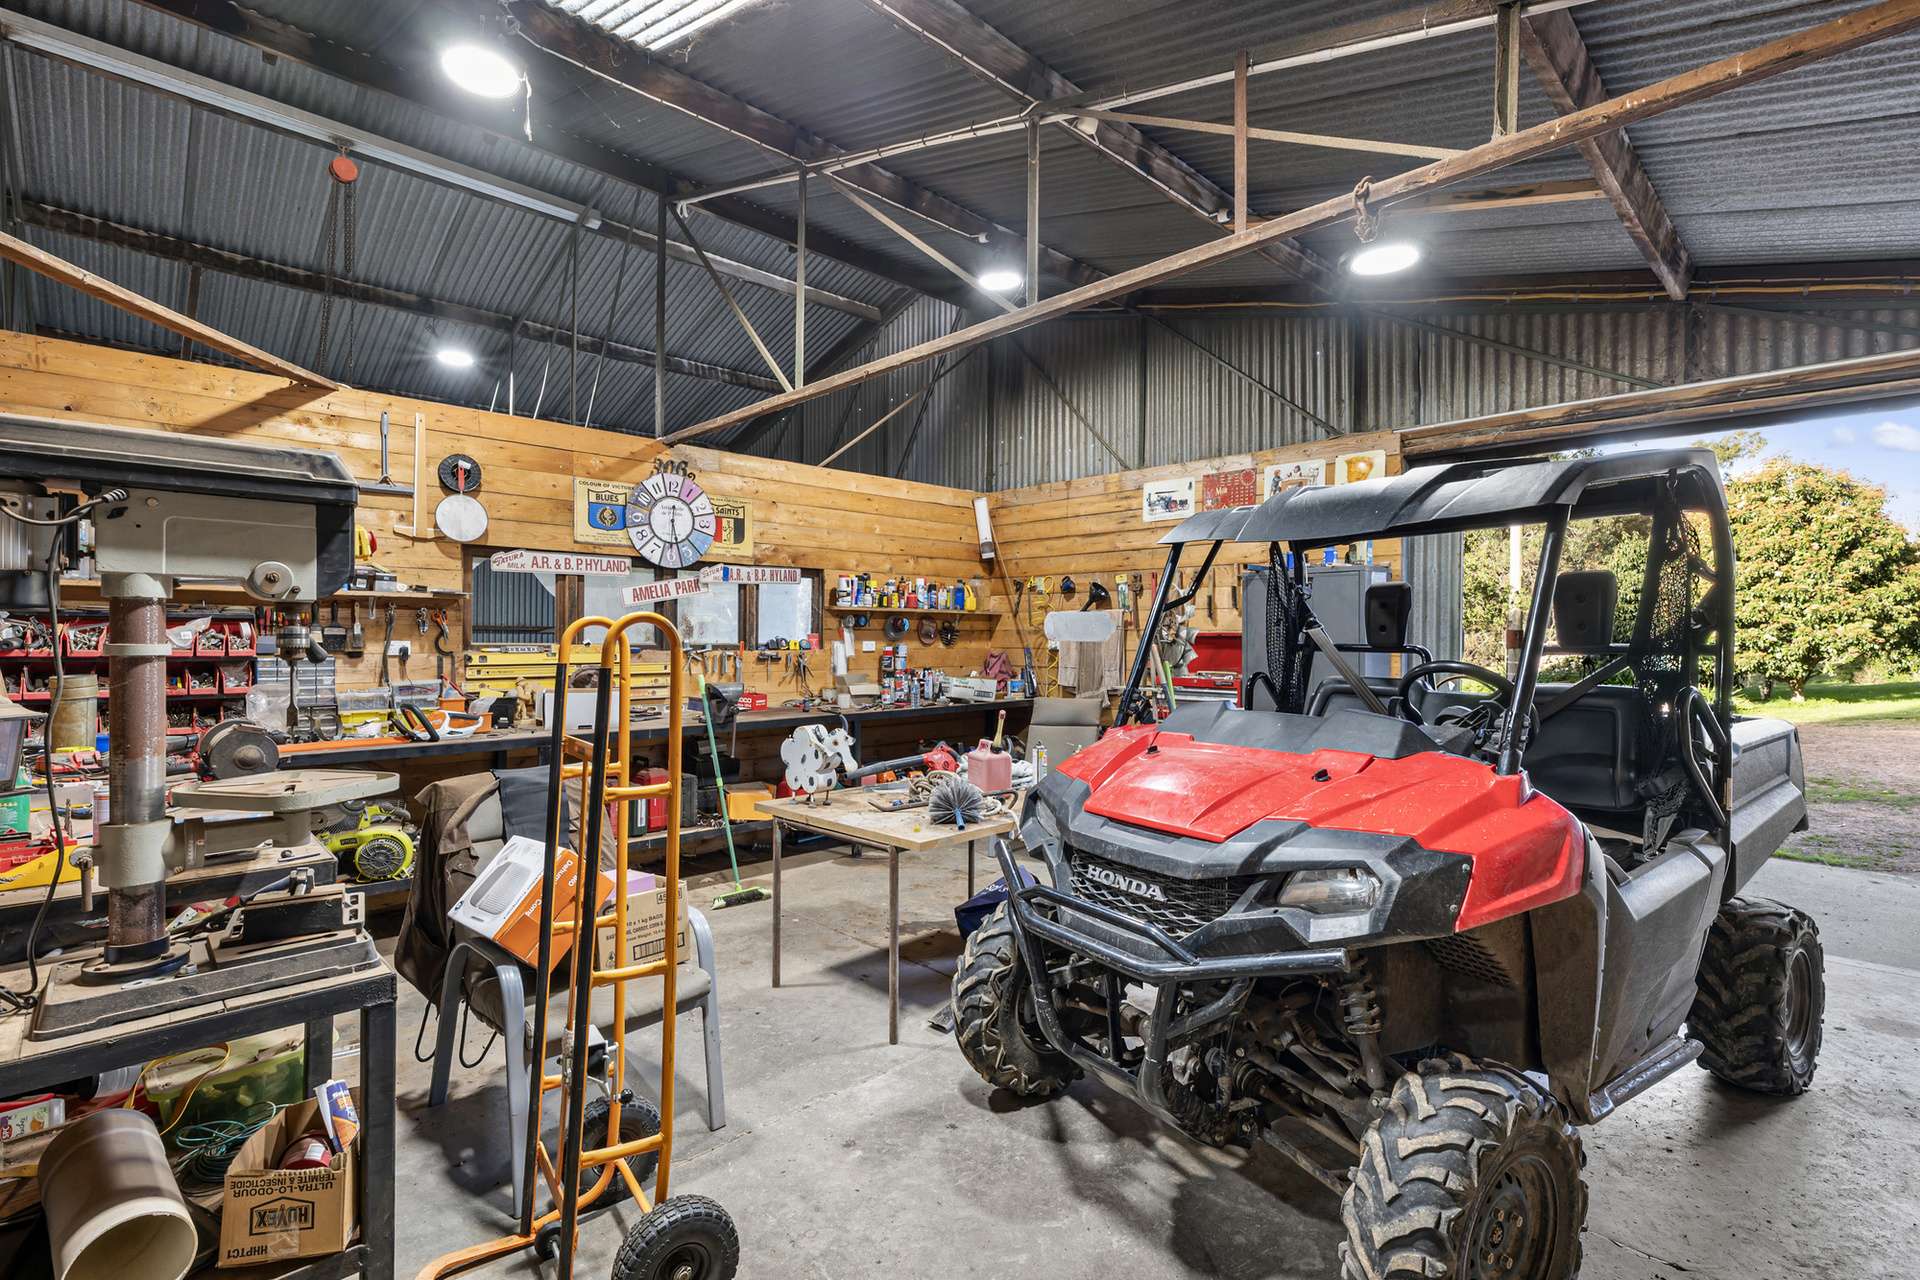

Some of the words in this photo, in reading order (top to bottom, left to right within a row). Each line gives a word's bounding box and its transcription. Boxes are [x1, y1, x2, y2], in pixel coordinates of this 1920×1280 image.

[651, 482, 662, 495] 11
[668, 480, 679, 494] 12
[595, 493, 619, 503] BLUES
[715, 506, 740, 516] SAINTS
[531, 556, 553, 570] A.R.
[554, 558, 562, 570] &
[585, 558, 628, 574] HYLAND
[729, 567, 744, 582] A.R.
[769, 569, 798, 583] HYLAND
[631, 582, 671, 603] AMELIA
[674, 578, 701, 595] PARK
[1086, 863, 1168, 903] HONDA
[230, 1176, 287, 1190] INSECTICIDE
[295, 1172, 337, 1184] TERMITE
[232, 1181, 333, 1198] ULTRA-LO-ODOUR
[226, 1244, 269, 1259] HHPTC1
